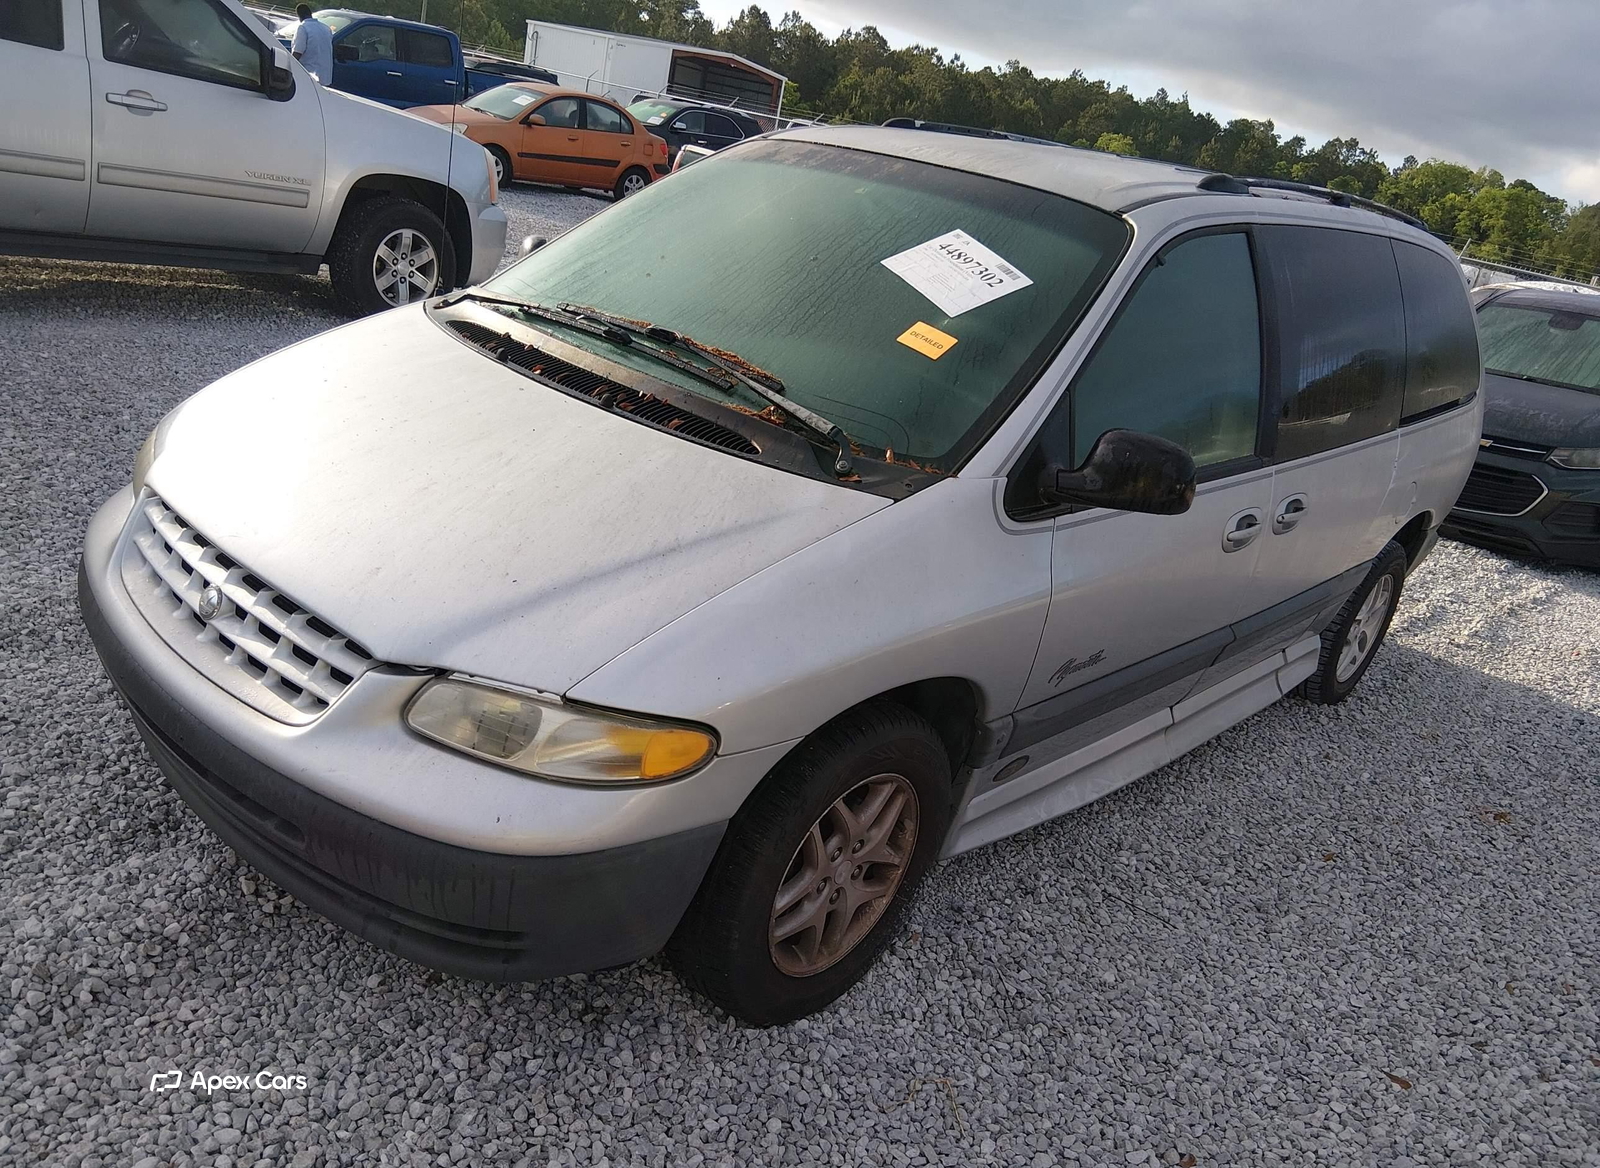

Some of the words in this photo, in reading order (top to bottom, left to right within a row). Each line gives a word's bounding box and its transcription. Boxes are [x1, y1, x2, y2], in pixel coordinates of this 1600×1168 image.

[244, 170, 290, 183] YUKON
[292, 177, 312, 186] XL
[938, 242, 1004, 288] 44897302
[909, 330, 944, 350] DETAILED
